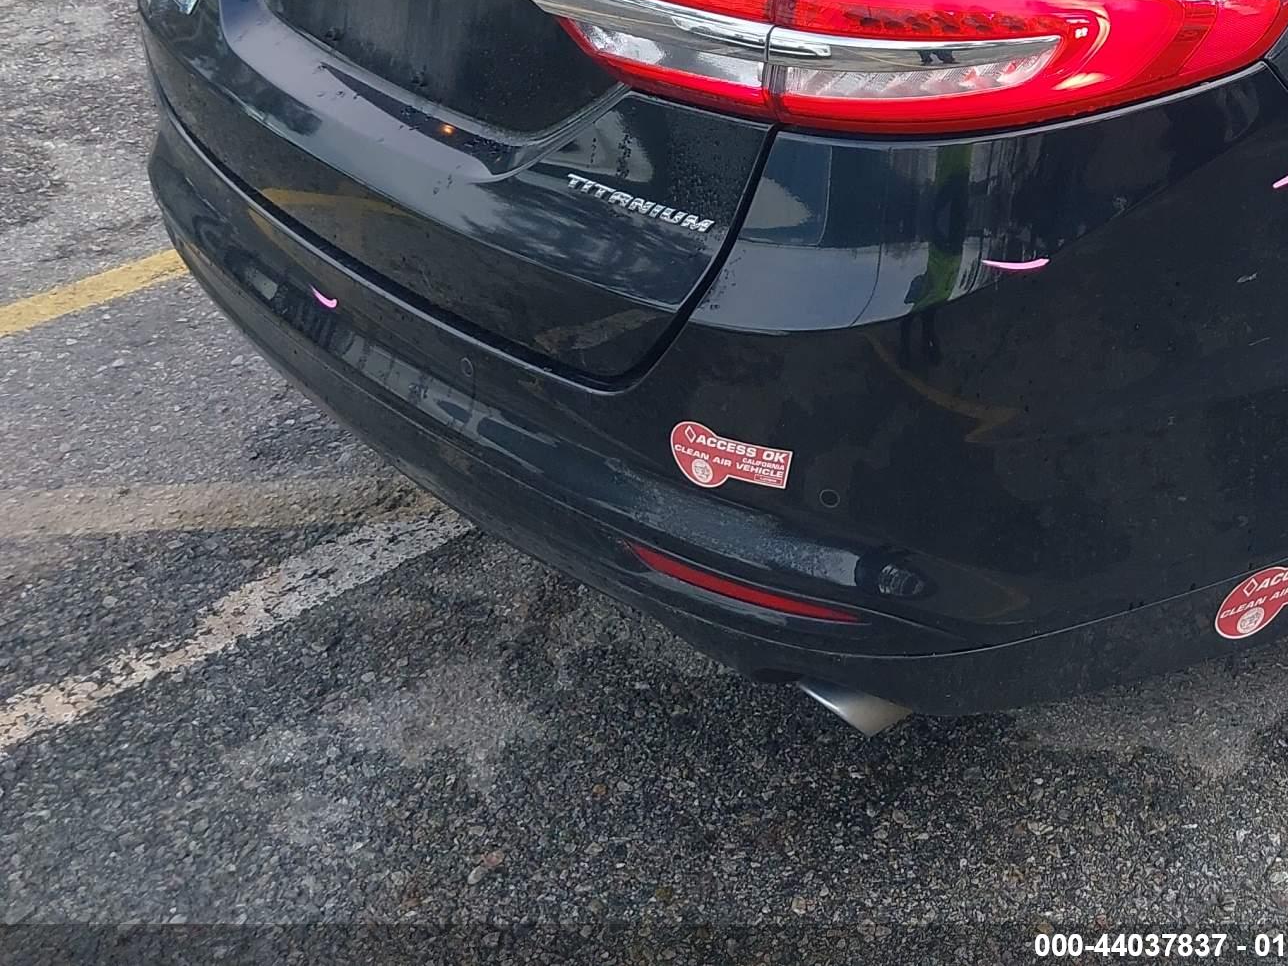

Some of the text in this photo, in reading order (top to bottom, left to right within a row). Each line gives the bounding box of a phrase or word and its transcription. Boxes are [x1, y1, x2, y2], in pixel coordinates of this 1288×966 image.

[567, 173, 715, 233] TITANIUM
[674, 444, 785, 478] CLEAN AIR VEHICLE
[696, 434, 788, 464] ACCESS OK
[742, 457, 785, 471] CALIFORNIA
[1219, 596, 1267, 620] CLEAN
